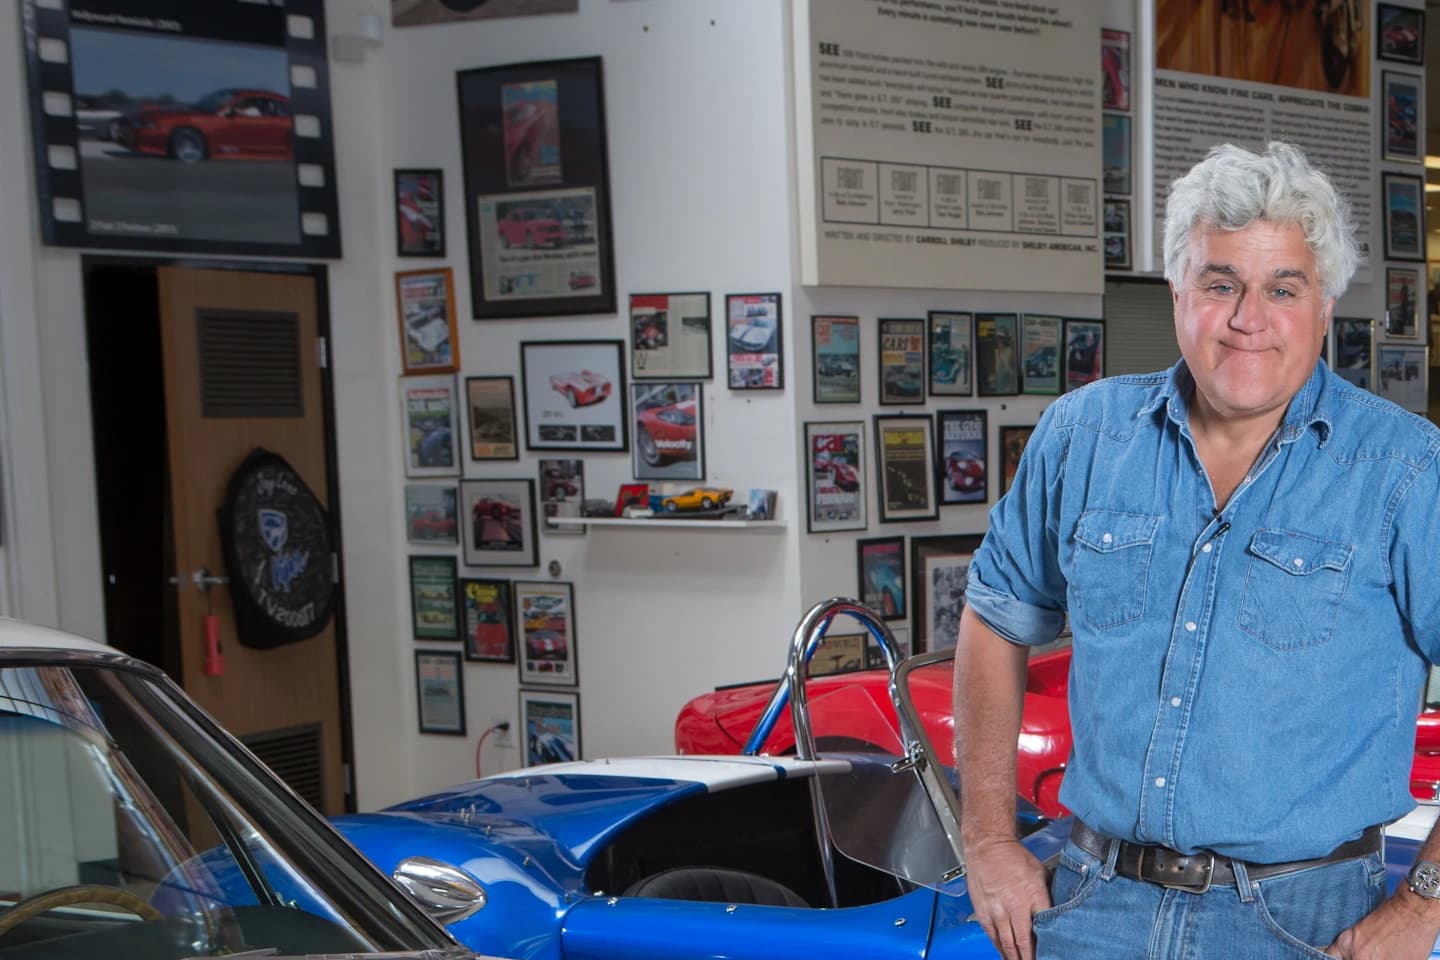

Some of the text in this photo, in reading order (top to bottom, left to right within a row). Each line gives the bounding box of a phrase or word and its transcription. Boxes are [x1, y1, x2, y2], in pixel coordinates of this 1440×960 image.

[819, 42, 840, 56] SEE
[985, 76, 1004, 89] SEE
[1154, 77, 1176, 89] MEN
[1178, 81, 1199, 92] WHO
[1201, 84, 1229, 96] KNOW
[1230, 88, 1249, 98] FINE
[1278, 94, 1325, 109] APPRECIATE
[1327, 100, 1342, 110] THE
[932, 95, 952, 109] SEE
[912, 120, 932, 134] SEE
[1014, 119, 1032, 132] SEE
[856, 232, 871, 241] AND
[916, 235, 949, 245] CARROLL
[950, 237, 976, 247] SHELBY
[1022, 241, 1047, 250] SHELBY
[882, 336, 909, 350] CARS
[655, 440, 693, 451] Velocity
